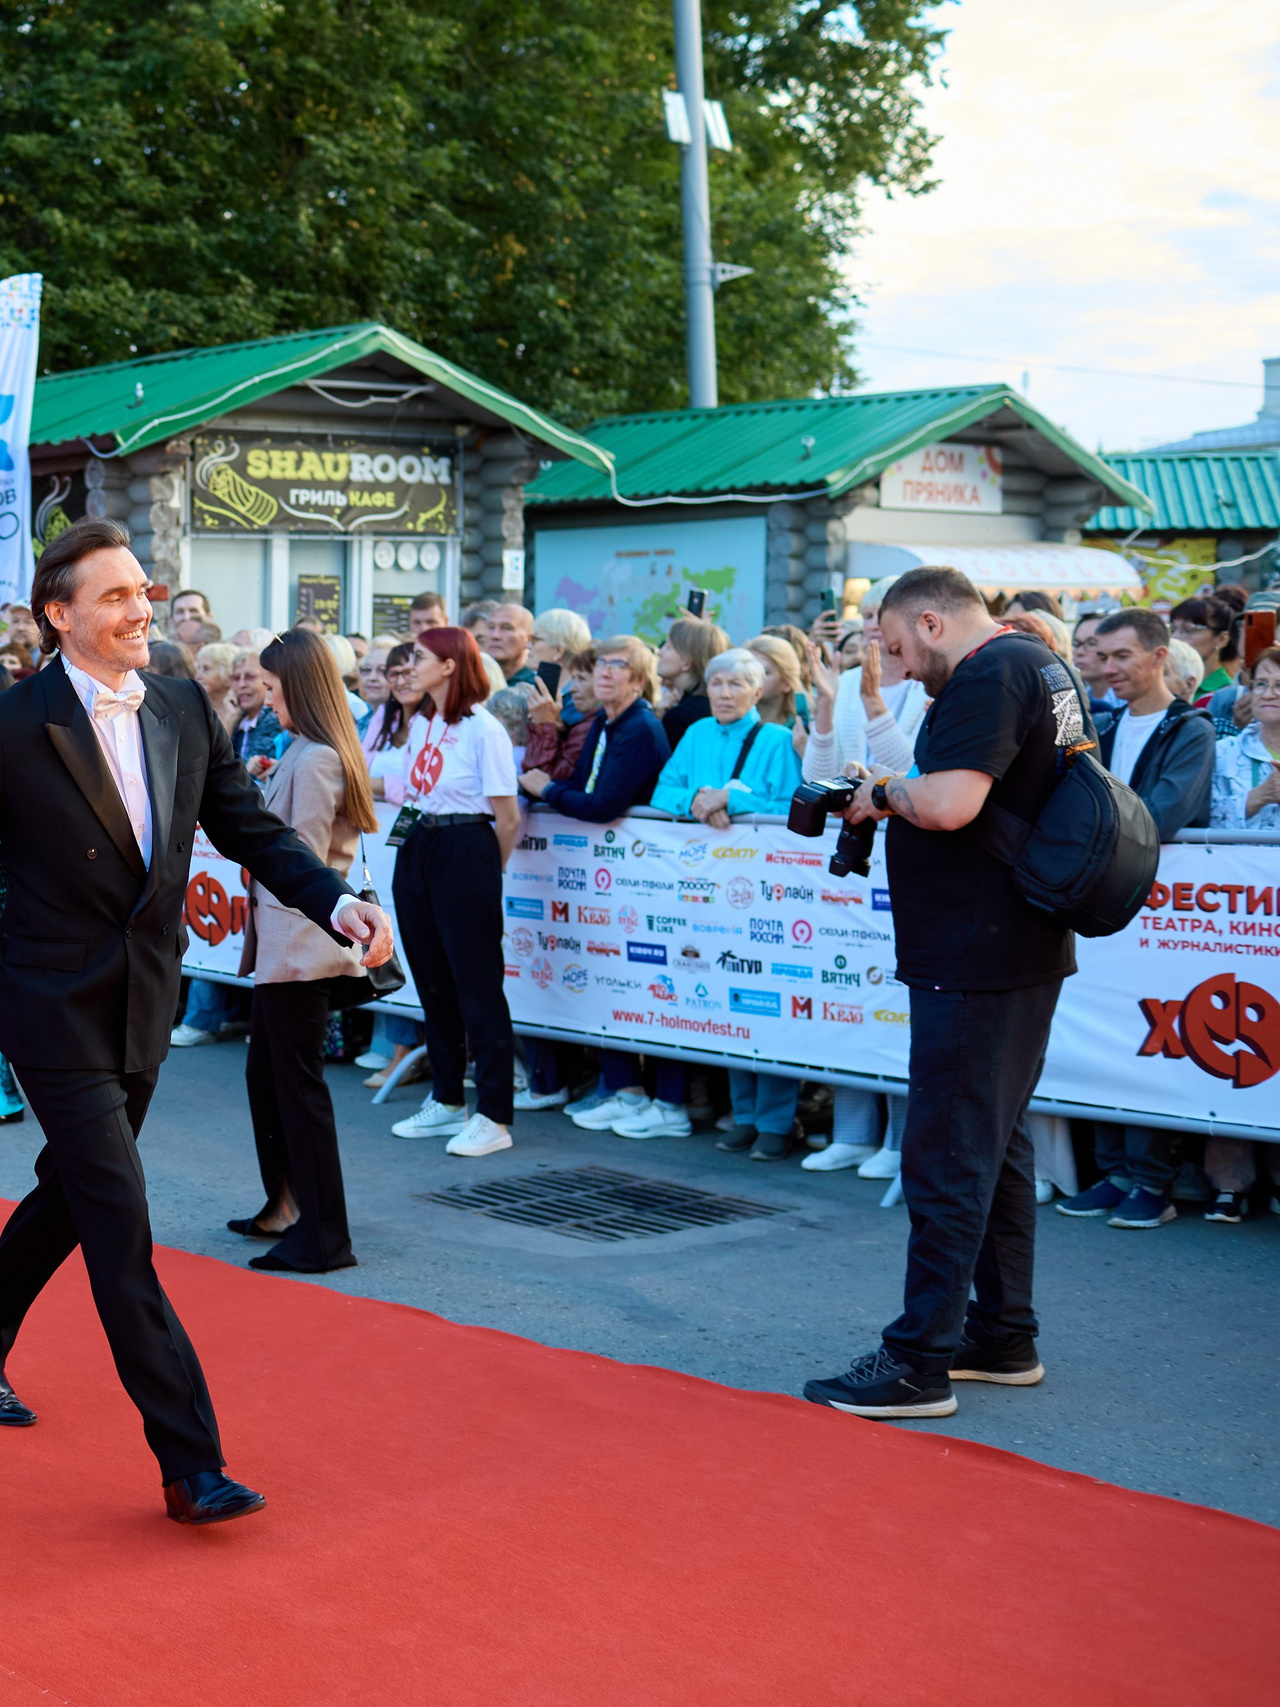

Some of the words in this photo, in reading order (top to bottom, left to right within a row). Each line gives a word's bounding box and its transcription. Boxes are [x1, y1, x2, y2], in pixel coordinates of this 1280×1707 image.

[246, 449, 451, 485] SHAUROOM
[921, 449, 965, 476] ДОМ
[289, 488, 348, 506] ГРИЛЬ
[349, 489, 396, 508] КАФЕ
[902, 479, 982, 506] ПРЯНИКА
[593, 844, 626, 861] ВЯТИЧ
[558, 867, 587, 880] ПОЧТА
[558, 879, 587, 891] РОССИИ
[1144, 880, 1280, 917] ФЕСТИ
[656, 915, 687, 927] COFFEE
[749, 917, 784, 932] ПОЧТА
[1140, 916, 1224, 937] ТЕАТРА,
[656, 925, 674, 935] LIKE
[750, 931, 785, 945] РОССИИ
[562, 968, 589, 984] МОРЕ
[594, 975, 642, 990] УГОЛЬКИ
[821, 969, 861, 988] ВЯТИЧ
[685, 997, 722, 1010] PATRON
[612, 1009, 751, 1039] www.7-holmovfest.ru
